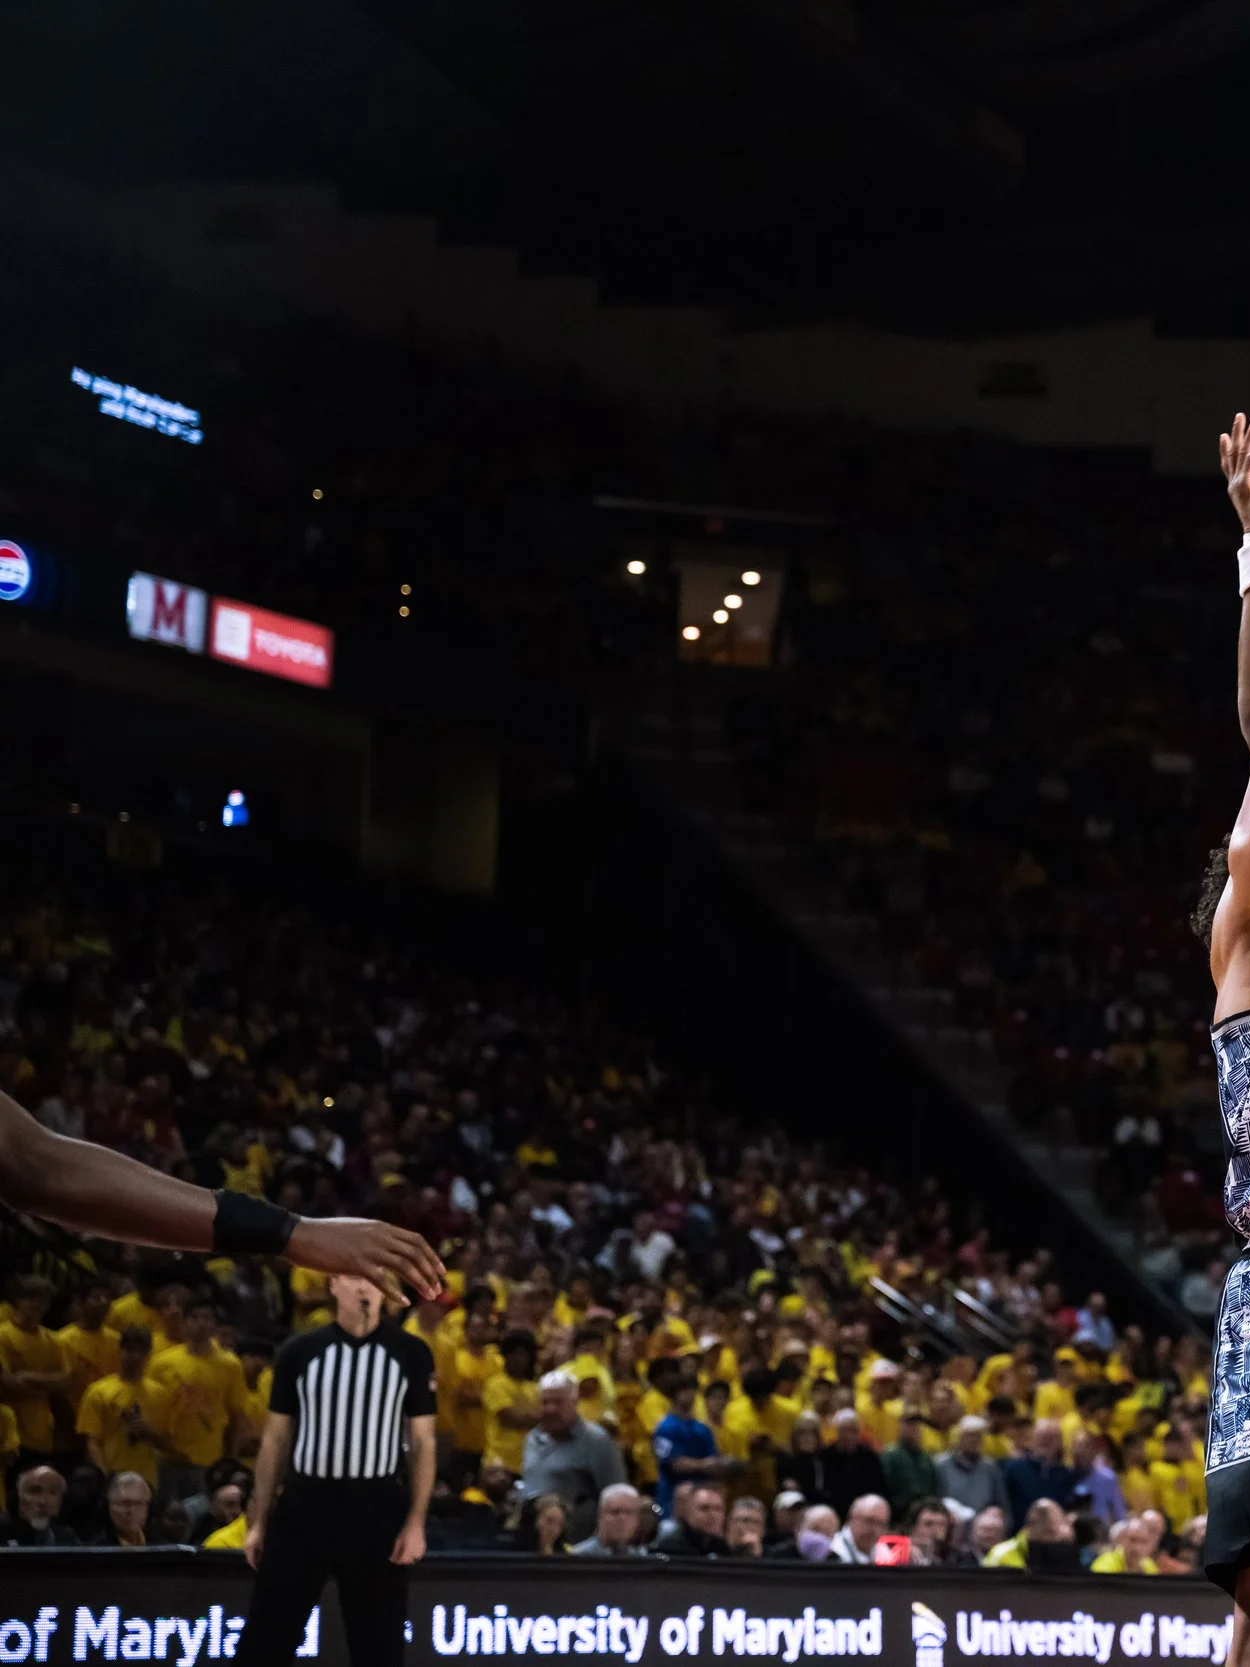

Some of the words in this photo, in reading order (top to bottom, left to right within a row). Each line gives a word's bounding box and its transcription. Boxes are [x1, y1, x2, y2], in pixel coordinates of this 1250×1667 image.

[0, 1606, 59, 1662] of
[432, 1605, 648, 1663] University
[660, 1605, 705, 1656] of
[712, 1607, 883, 1663] Maryland
[956, 1610, 1115, 1664] University
[1120, 1612, 1155, 1657] of
[1159, 1614, 1235, 1665] Maryl
